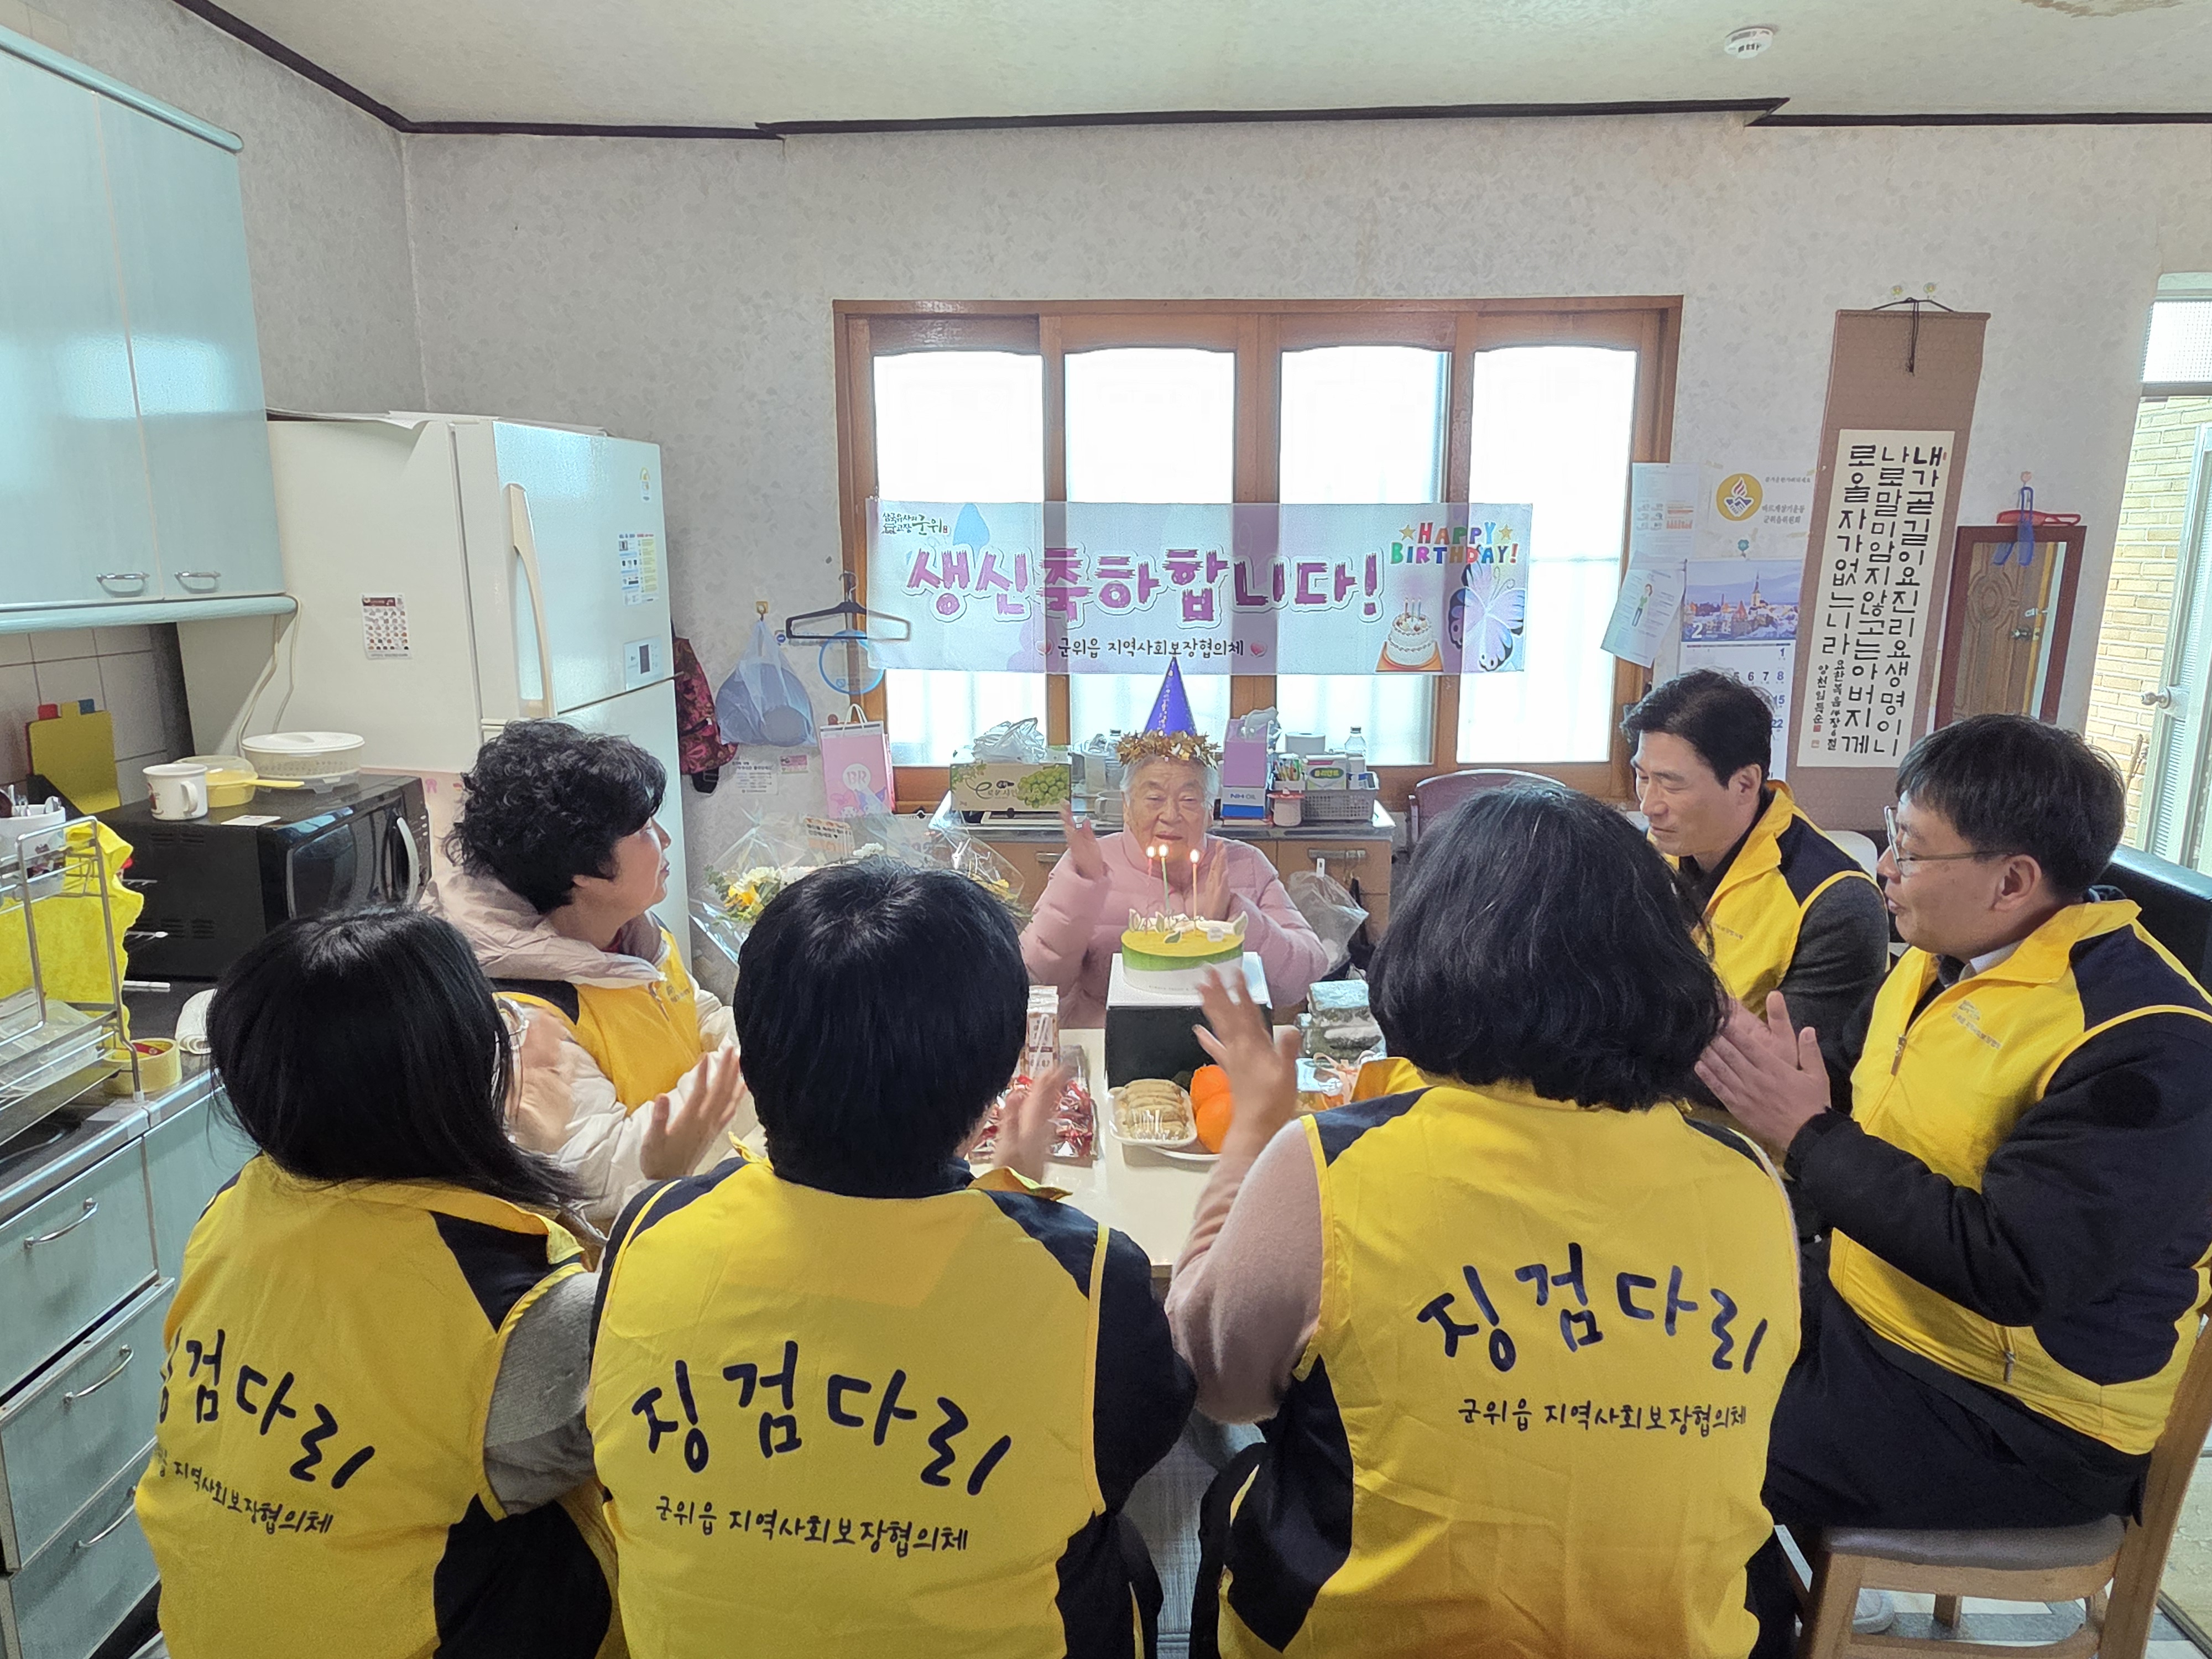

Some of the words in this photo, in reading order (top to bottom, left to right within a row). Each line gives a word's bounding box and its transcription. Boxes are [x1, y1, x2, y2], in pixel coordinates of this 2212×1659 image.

[912, 514, 942, 535] 군위
[1418, 522, 1496, 545] HAPPY
[1391, 541, 1518, 565] BIRTHDAY!
[1692, 623, 1703, 638] 2
[1058, 637, 1100, 658] 군위읍
[1108, 637, 1244, 658] 지역사회보장협의체
[1780, 648, 1785, 656] 1
[1748, 672, 1754, 681] 6
[1762, 672, 1769, 681] 7
[1777, 671, 1784, 680] 8
[1773, 695, 1785, 705] 15
[1771, 719, 1783, 728] 22
[1416, 1242, 1768, 1374] 징검다리
[632, 1340, 1011, 1495] 징검다리
[1458, 1399, 1532, 1432] 군위읍
[1544, 1400, 1746, 1438] 지역사회보장협의체
[174, 1462, 333, 1535] 지역사회보장협의체
[656, 1495, 717, 1536] 군위읍
[729, 1509, 968, 1558] 지역사회보장협의체
